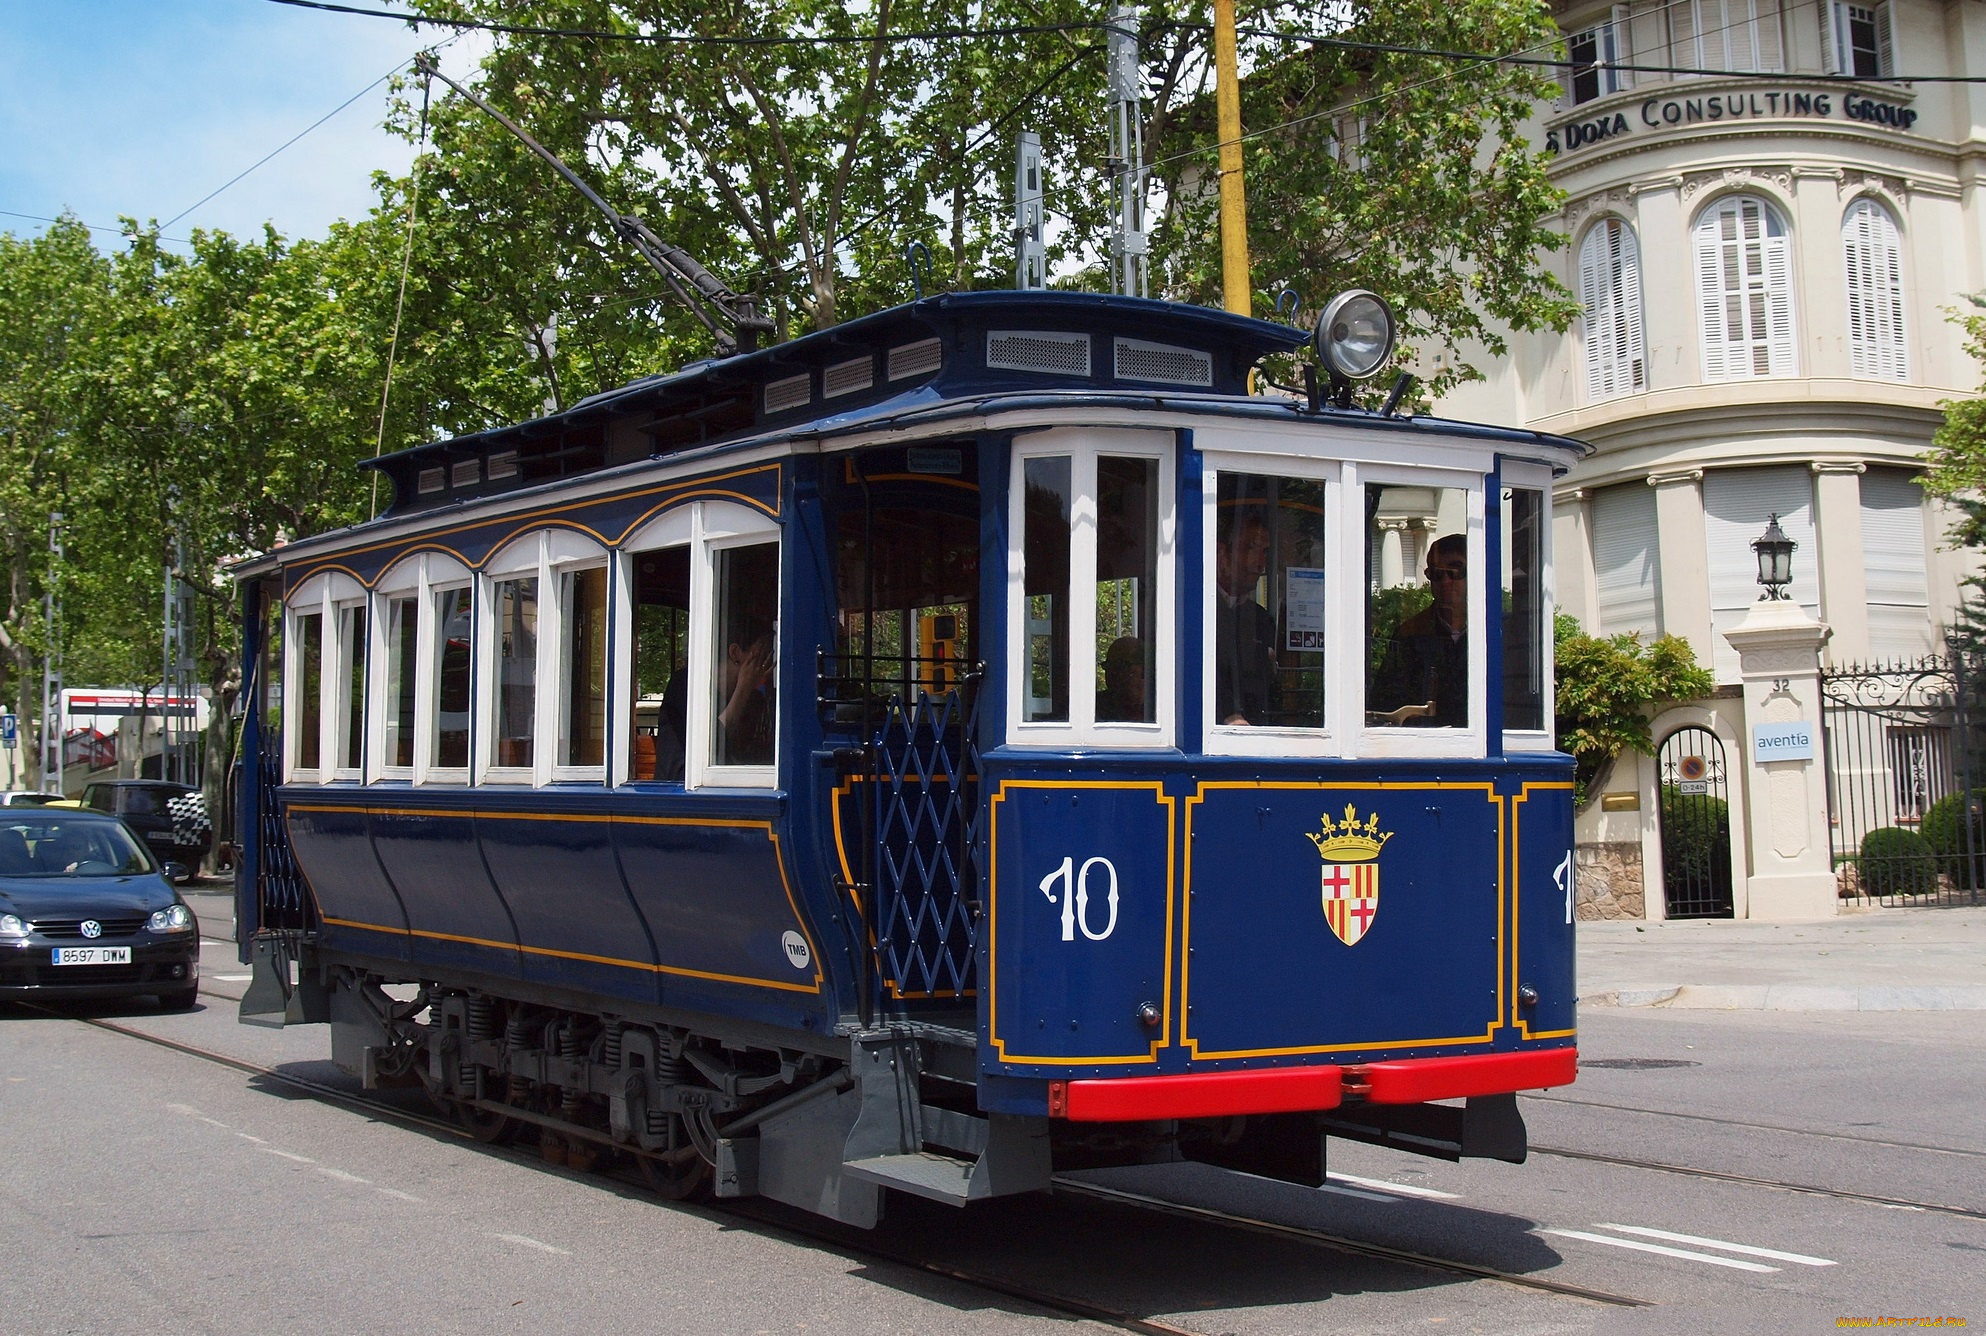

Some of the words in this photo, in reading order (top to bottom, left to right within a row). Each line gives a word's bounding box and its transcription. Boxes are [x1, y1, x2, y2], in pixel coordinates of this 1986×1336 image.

[1564, 113, 1630, 150] DOXA
[1641, 92, 1832, 127] CONSULTING
[1843, 92, 1918, 128] GROUP
[1772, 678, 1791, 692] 32
[4, 717, 14, 737] P
[1758, 733, 1809, 748] aventia
[1552, 849, 1577, 924] 1
[1039, 856, 1120, 941] 10
[63, 949, 95, 963] 8597
[102, 949, 126, 962] DWM
[787, 943, 807, 956] TMB
